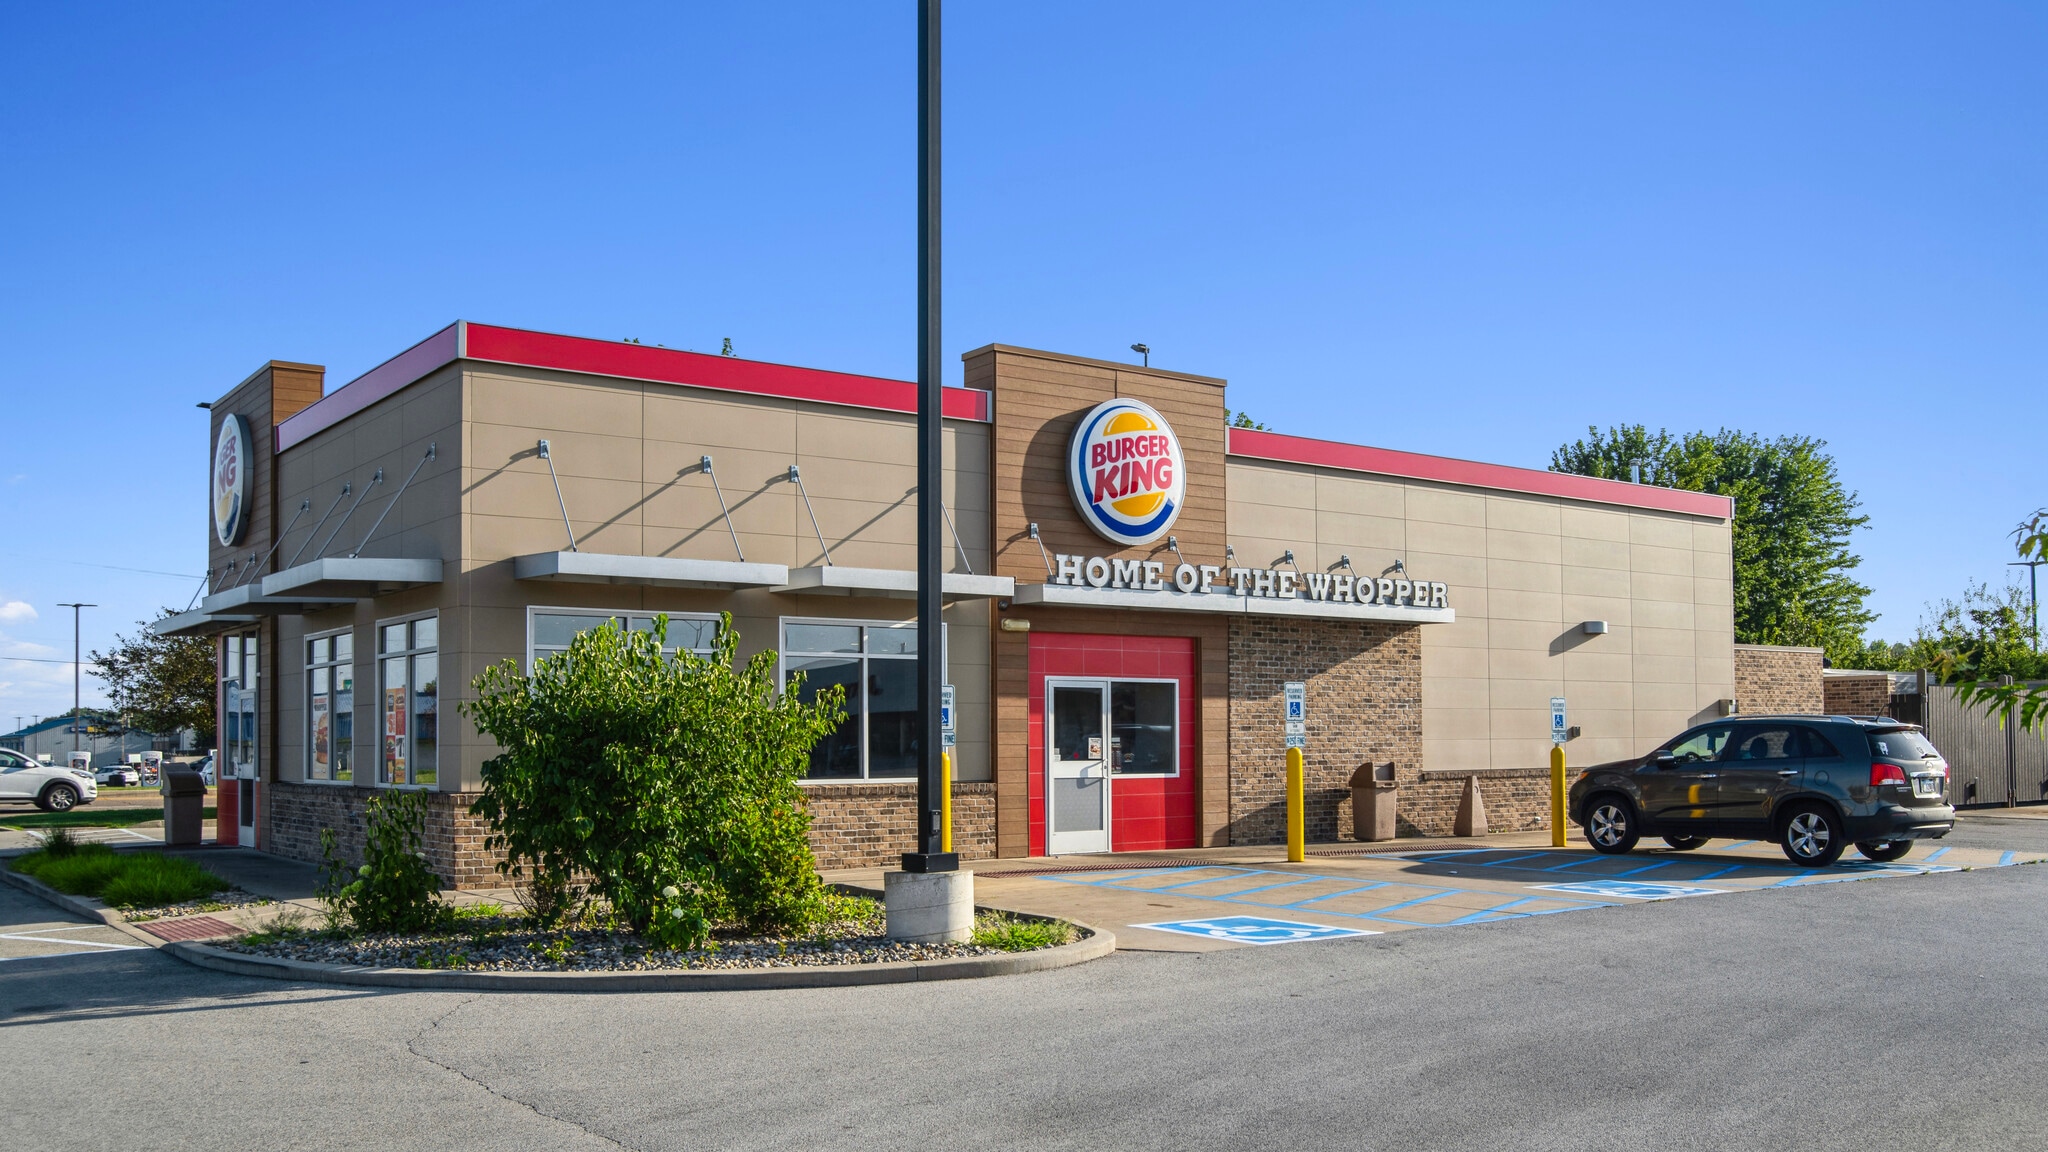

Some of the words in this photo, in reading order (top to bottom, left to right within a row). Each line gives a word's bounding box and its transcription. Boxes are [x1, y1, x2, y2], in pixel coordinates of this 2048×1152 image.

[1092, 435, 1170, 469] BURGER
[1094, 457, 1173, 504] KING
[1056, 553, 1164, 591] HOME
[1175, 563, 1220, 594] OF
[1229, 567, 1297, 598] THE
[1305, 572, 1449, 608] WHOPPER
